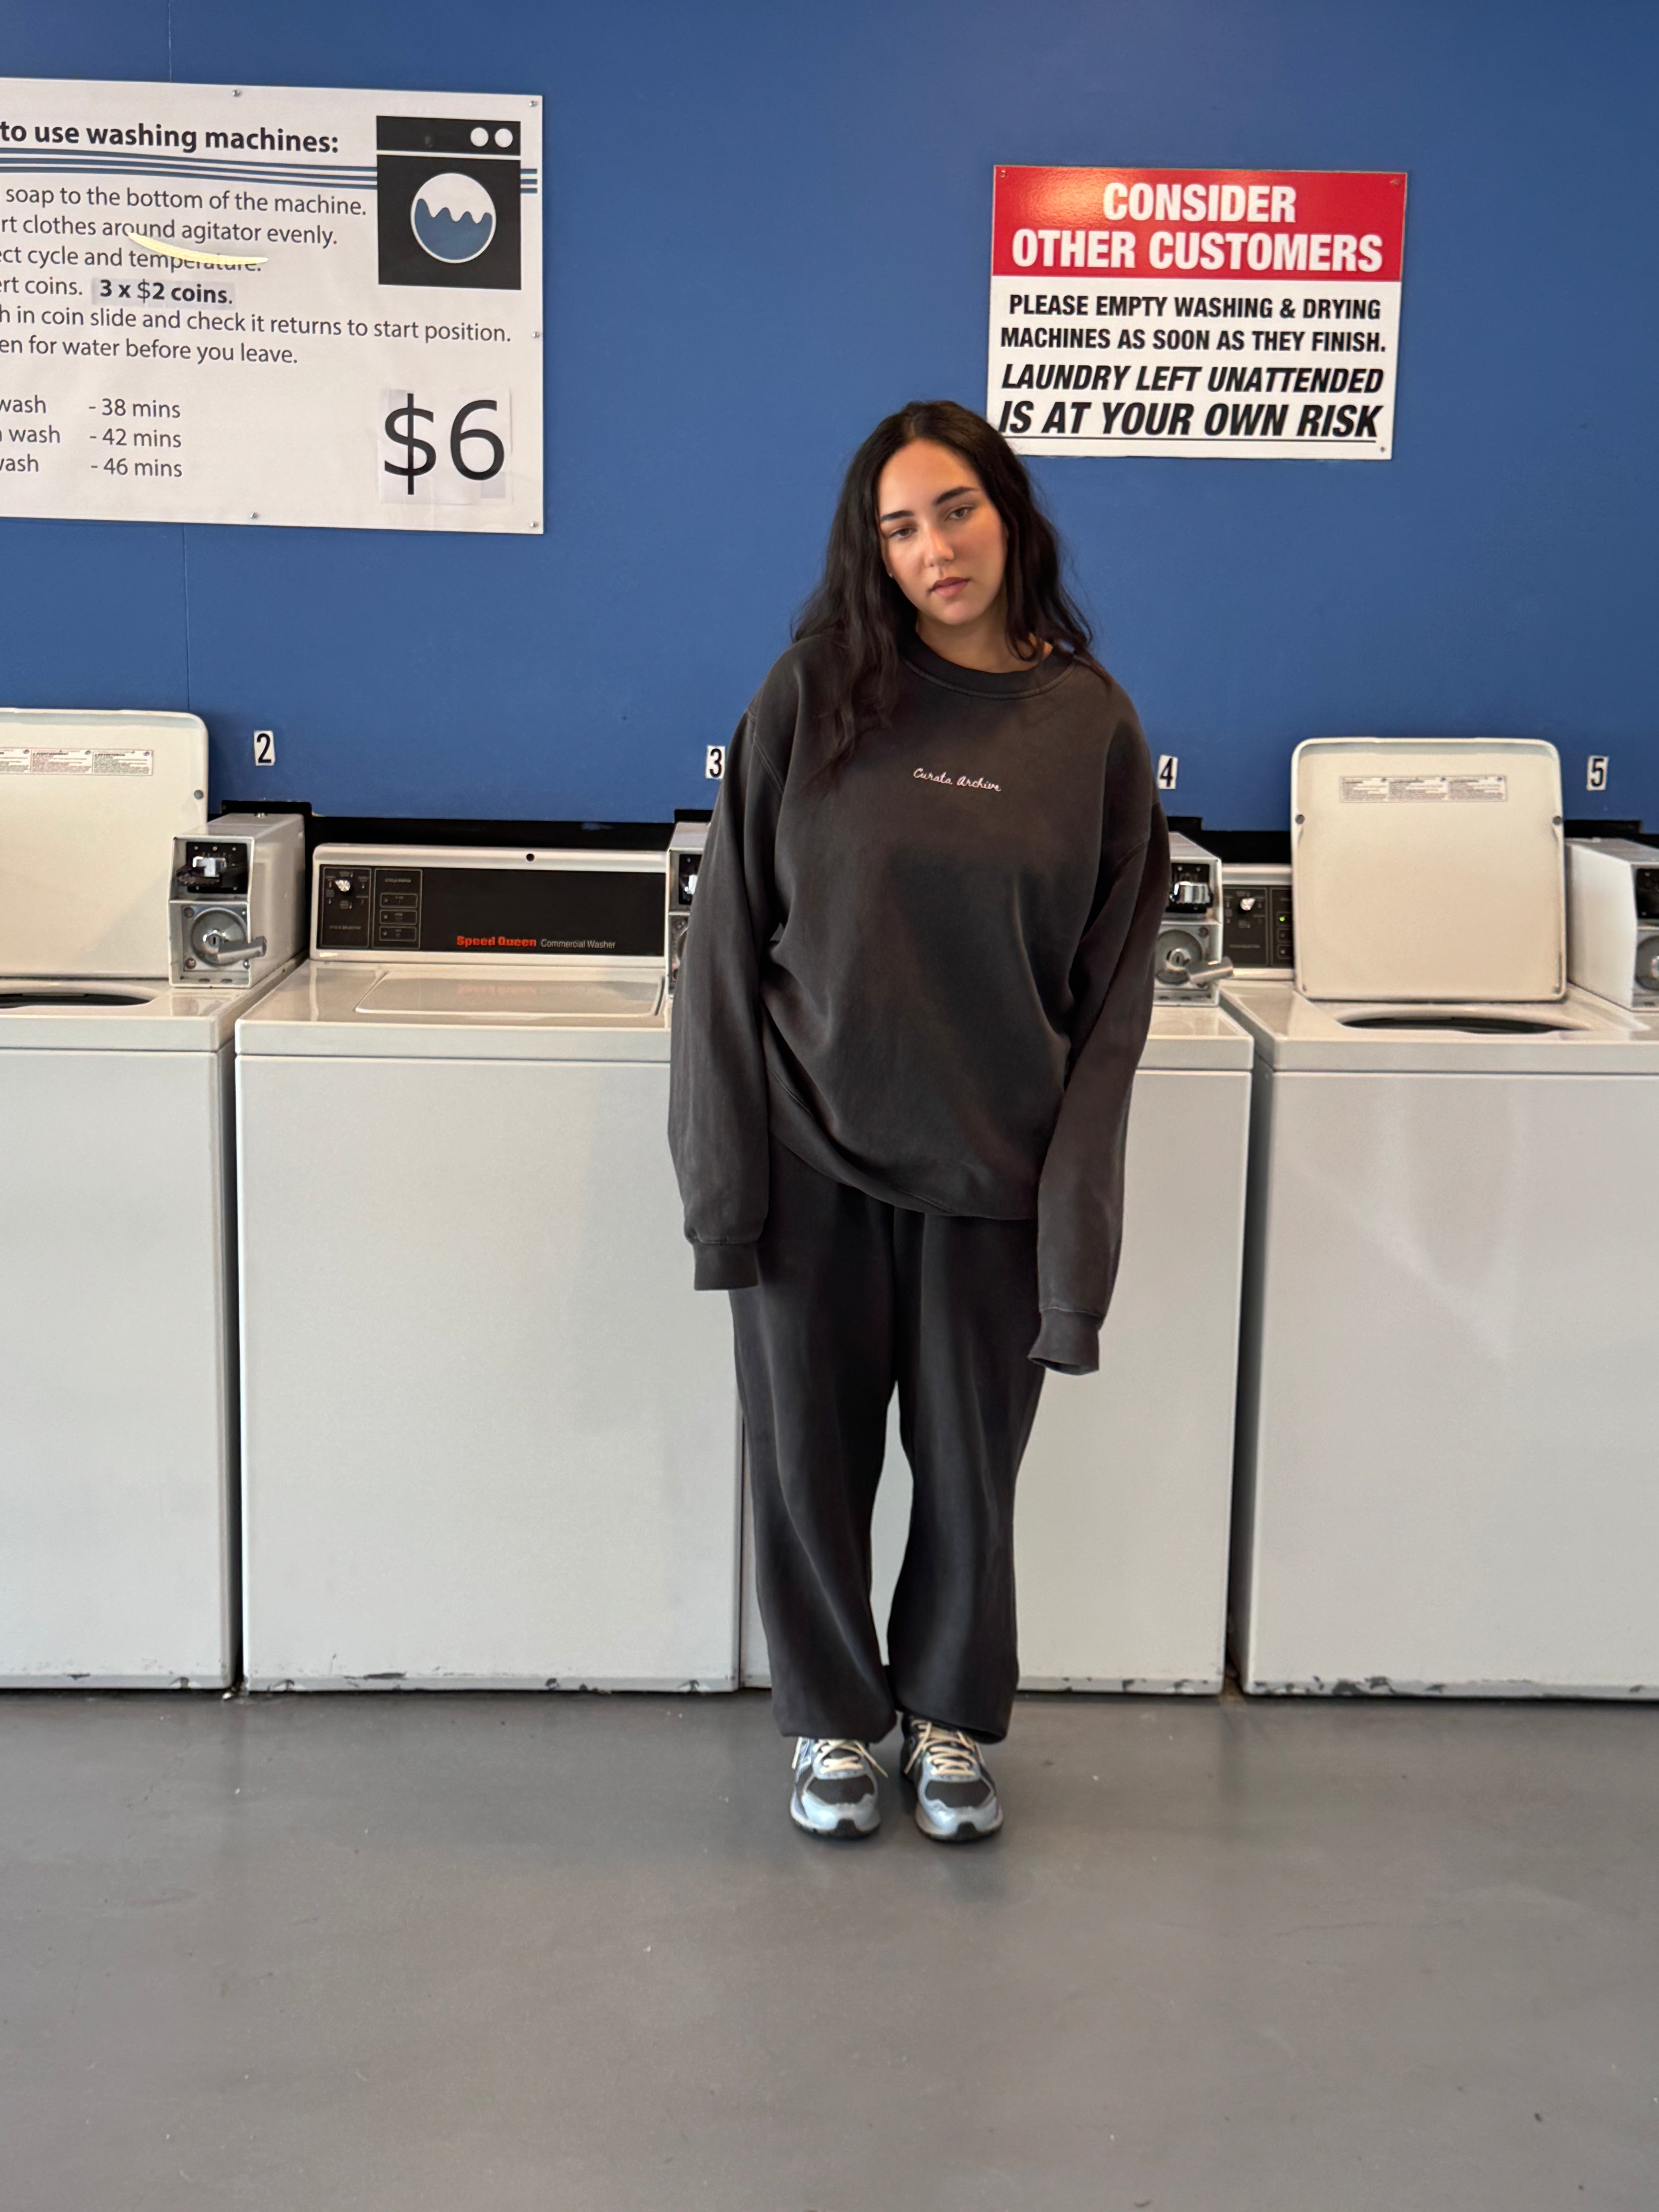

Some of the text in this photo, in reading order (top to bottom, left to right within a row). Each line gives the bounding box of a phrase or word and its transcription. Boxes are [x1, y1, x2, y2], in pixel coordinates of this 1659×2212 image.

[0, 121, 338, 153] to use washing machines:
[6, 186, 366, 216] soap to the bottom of the machine.
[1102, 182, 1297, 222] CONSIDER
[23, 214, 96, 235] clothes
[102, 219, 175, 238] around
[181, 221, 262, 244] agitator
[267, 225, 337, 249] evenly.
[27, 245, 79, 269] cycle
[84, 247, 122, 267] and
[1012, 229, 1382, 272] OTHER CUSTOMERS
[25, 276, 83, 296] coins.
[100, 279, 112, 297] 3
[118, 284, 131, 298] x
[137, 278, 165, 303] $2
[171, 283, 232, 304] coins.
[1010, 294, 1380, 320] PLEASE EMPTY WASHING & DRYING
[17, 305, 35, 324] in
[41, 307, 84, 325] coin
[91, 307, 137, 327] slide
[143, 310, 181, 329] and
[187, 311, 246, 331] check
[251, 314, 265, 332] it
[270, 317, 342, 335] returns
[347, 319, 368, 336] to
[374, 321, 419, 339] start
[425, 322, 511, 343] position.
[29, 334, 57, 354] for
[62, 339, 120, 356] water
[126, 338, 191, 359] before
[197, 346, 234, 365] you
[241, 342, 297, 363] leave.
[1001, 327, 1386, 352] MACHINES AS SOON AS THEY FINISH.
[1001, 364, 1384, 393] LAUNDRY LEFT UNATTENDED
[0, 394, 46, 413] wash
[102, 398, 126, 416] 38
[133, 400, 181, 418] mins
[998, 400, 1384, 438] IS AT YOUR OWN RISK
[8, 424, 60, 443] wash
[102, 428, 127, 446] 42
[133, 429, 181, 448] mins
[385, 393, 505, 495] $6
[0, 453, 38, 472] ash
[103, 458, 128, 476] 46
[134, 459, 182, 477] mins
[257, 733, 272, 763] 2
[709, 748, 722, 779] 3
[1160, 757, 1173, 787] 4
[1591, 758, 1604, 787] 5
[957, 776, 1001, 791] Archive
[457, 935, 616, 949] Speed Queen Commercial Washer
